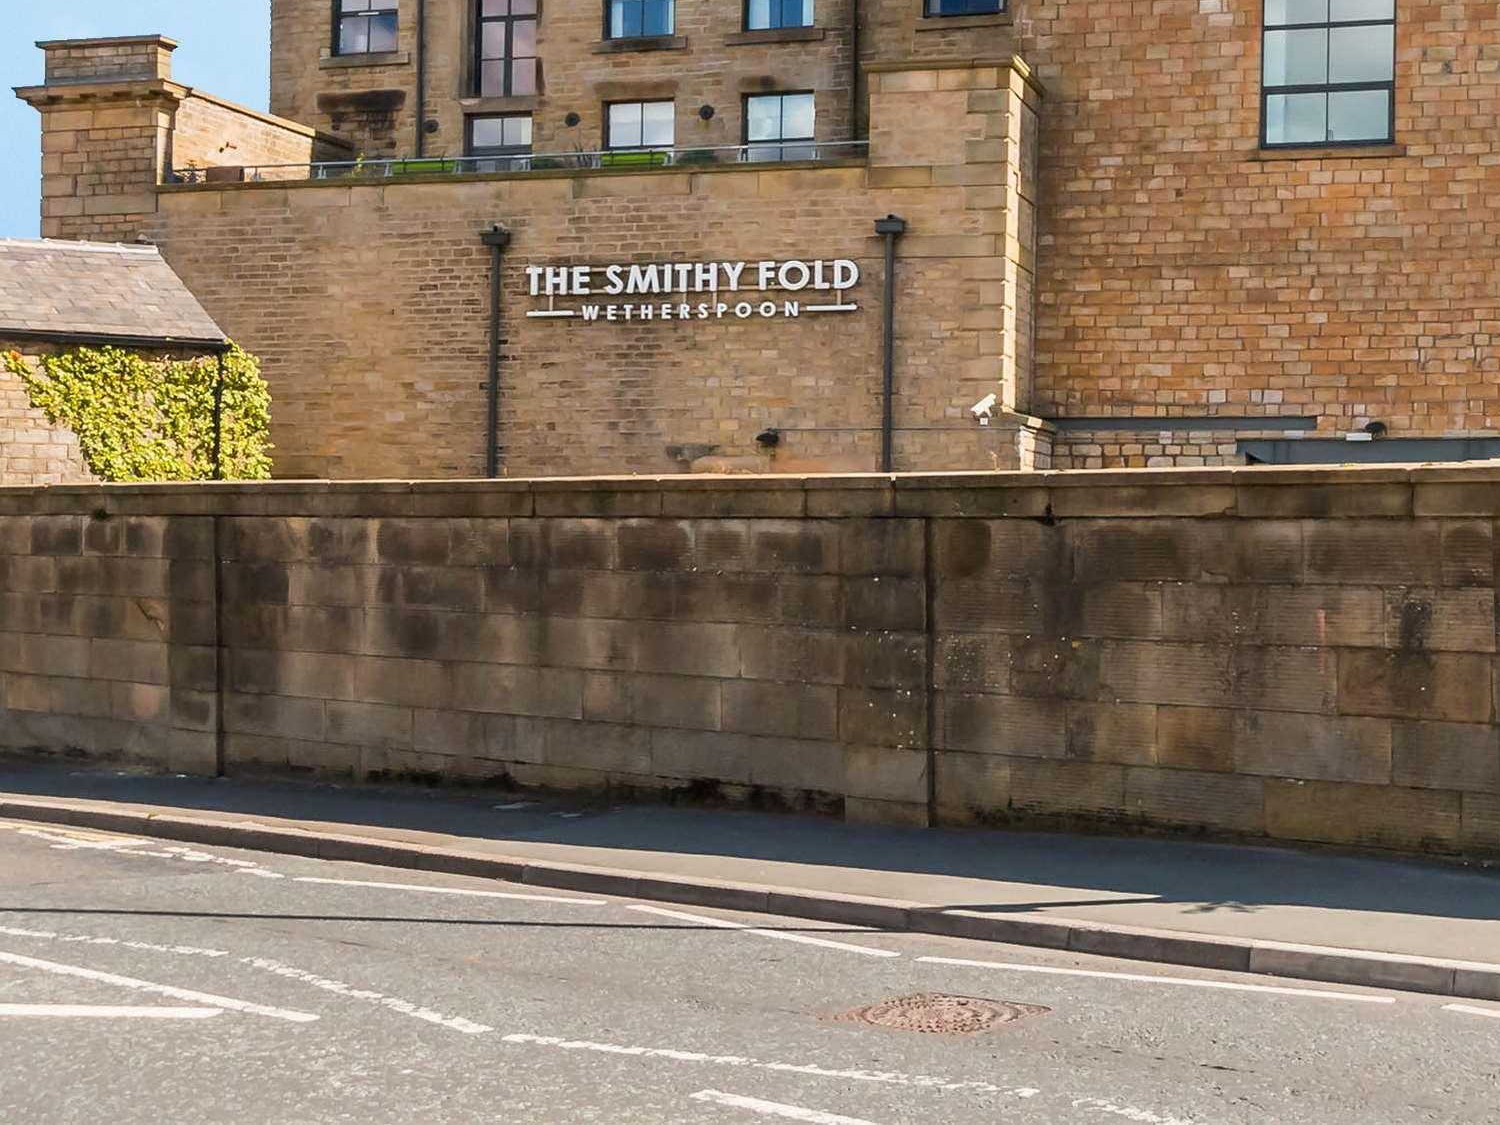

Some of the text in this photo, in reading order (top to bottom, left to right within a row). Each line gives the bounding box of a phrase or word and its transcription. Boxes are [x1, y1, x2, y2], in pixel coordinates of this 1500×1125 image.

[526, 259, 859, 295] THE SMITHY FOLD
[582, 301, 799, 321] WETHERSPOON
